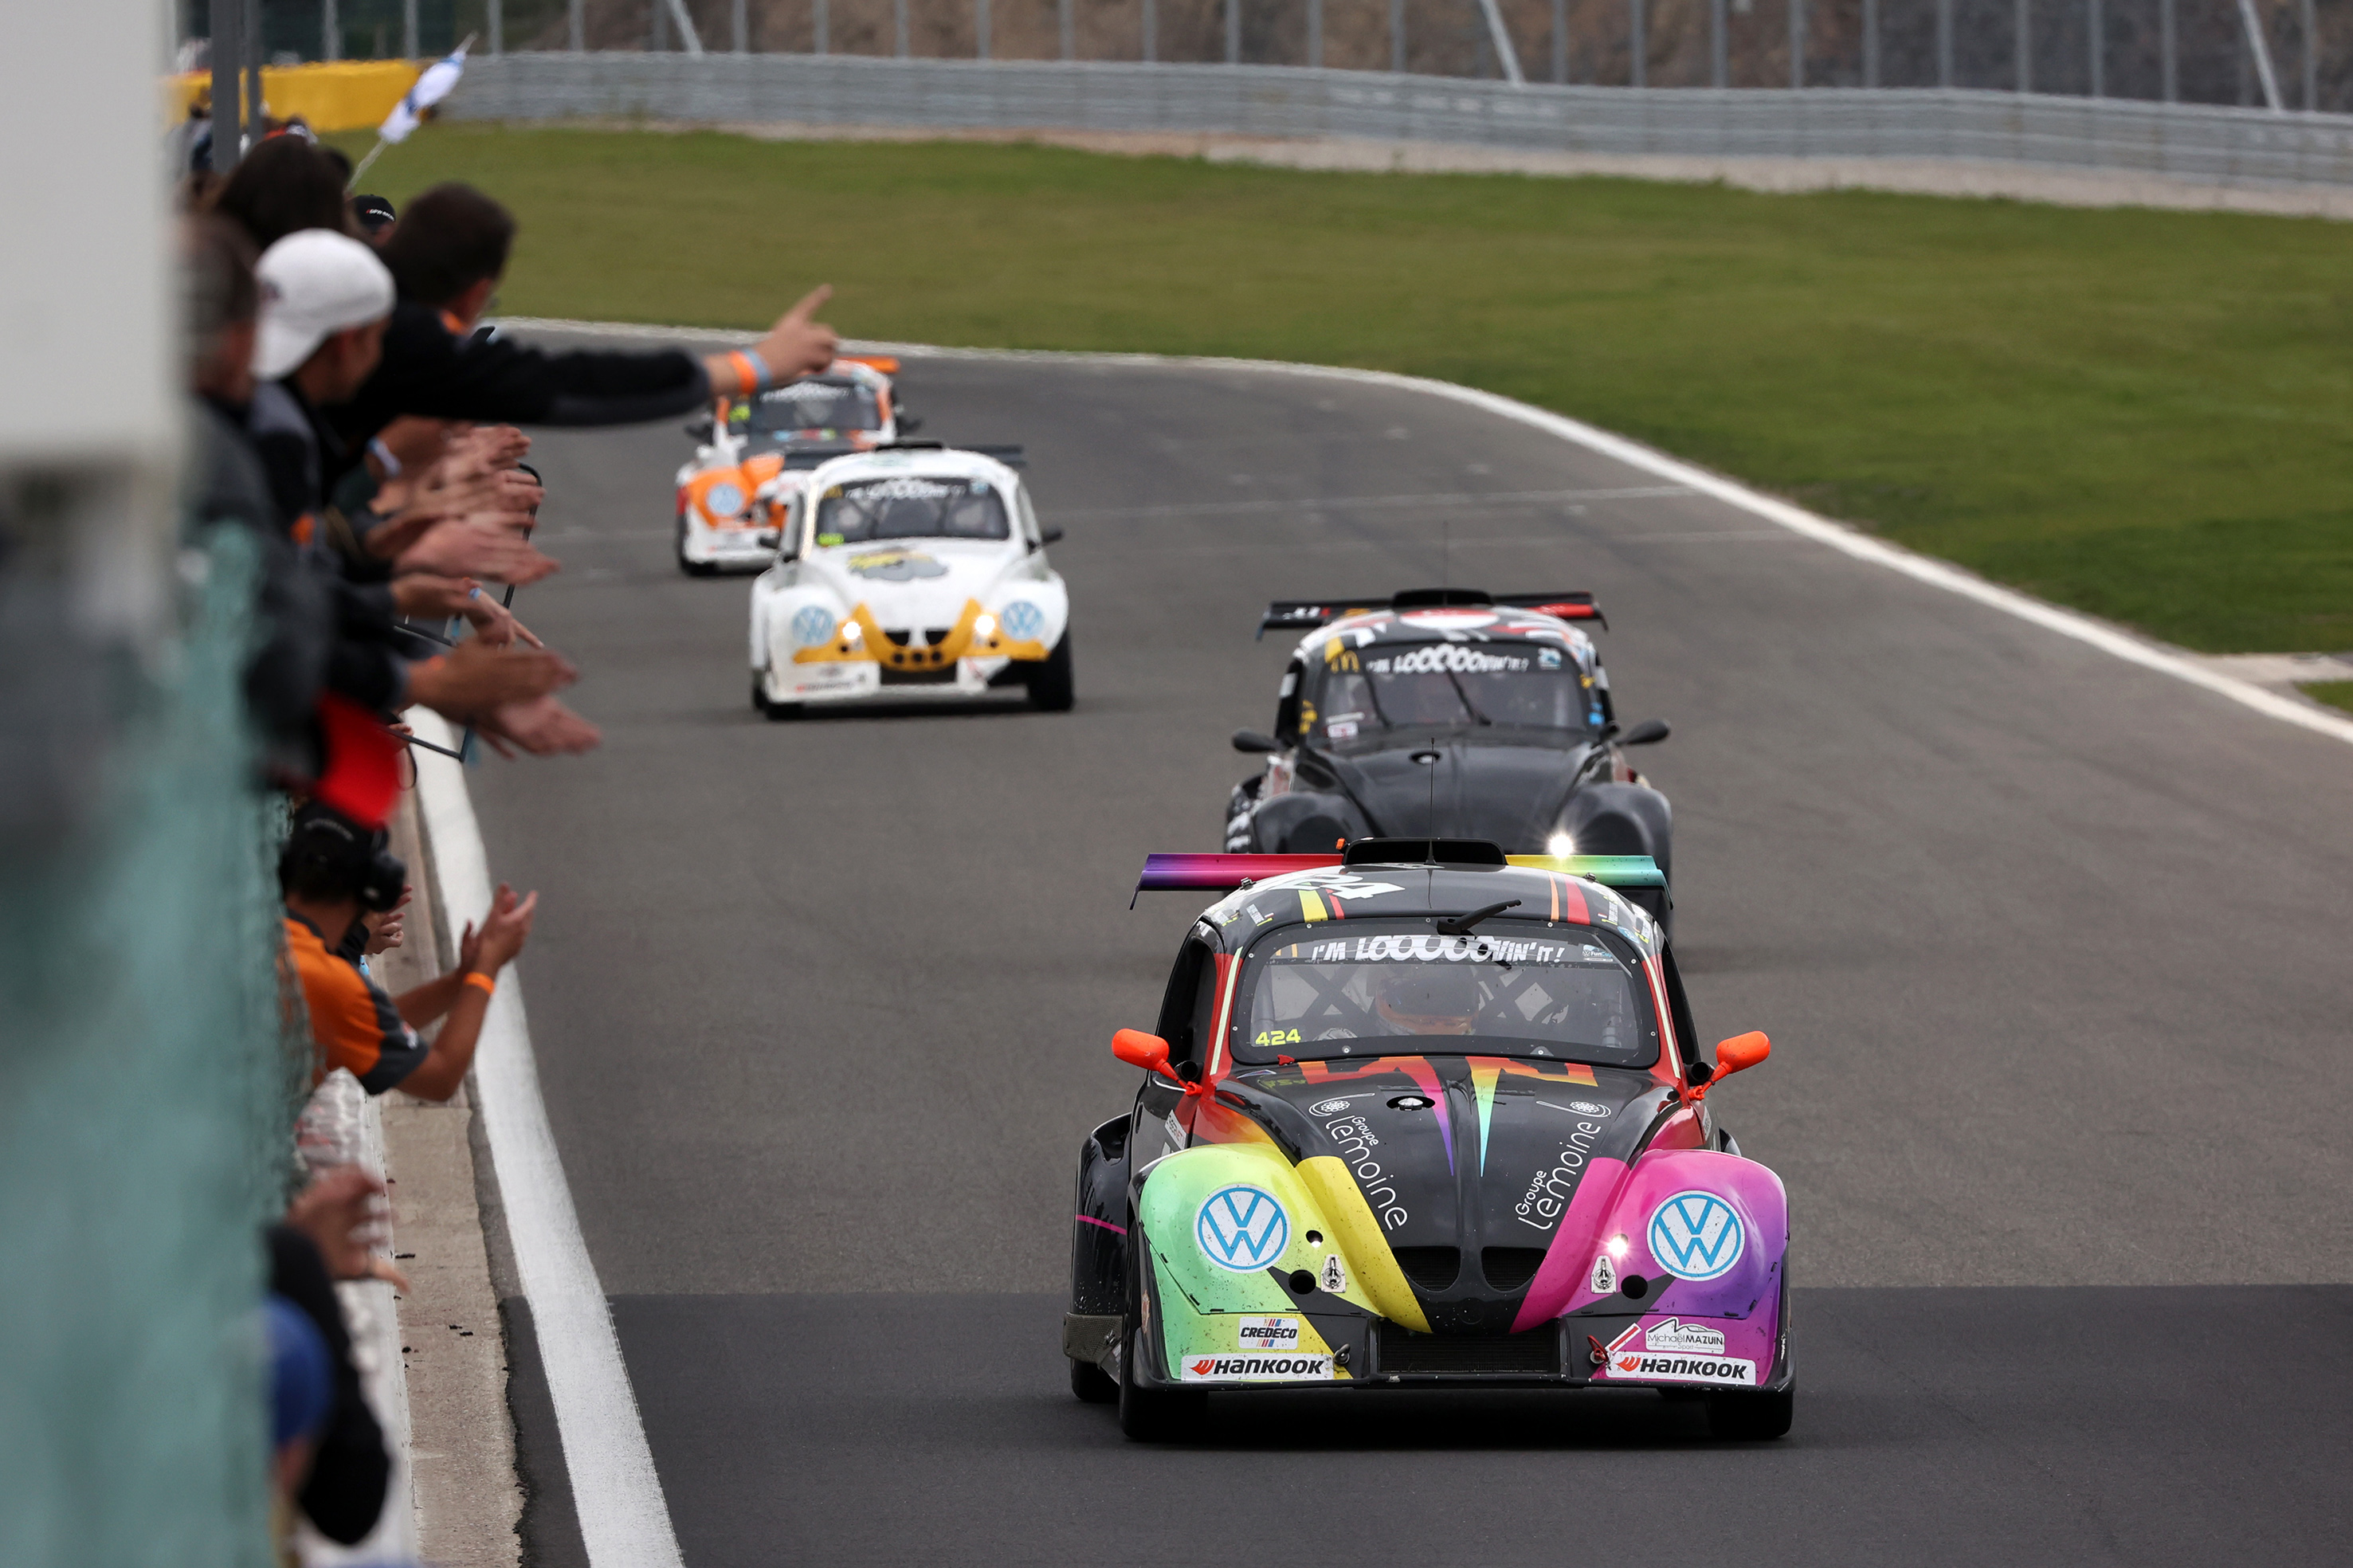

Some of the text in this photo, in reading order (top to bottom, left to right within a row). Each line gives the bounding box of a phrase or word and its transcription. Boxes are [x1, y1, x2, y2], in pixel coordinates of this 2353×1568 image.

[1312, 942, 1347, 962] I'M
[1255, 1028, 1301, 1047] 424
[1351, 1116, 1379, 1147] Groupe
[1325, 1115, 1408, 1231] Lemoine
[1518, 1122, 1602, 1230] Lemoine
[1516, 1170, 1547, 1216] Groupe
[1240, 1327, 1298, 1339] CREDECO
[1685, 1335, 1724, 1346] MAZUIN
[1213, 1358, 1325, 1375] HANKOOK
[1639, 1357, 1747, 1380] HANKOOK
